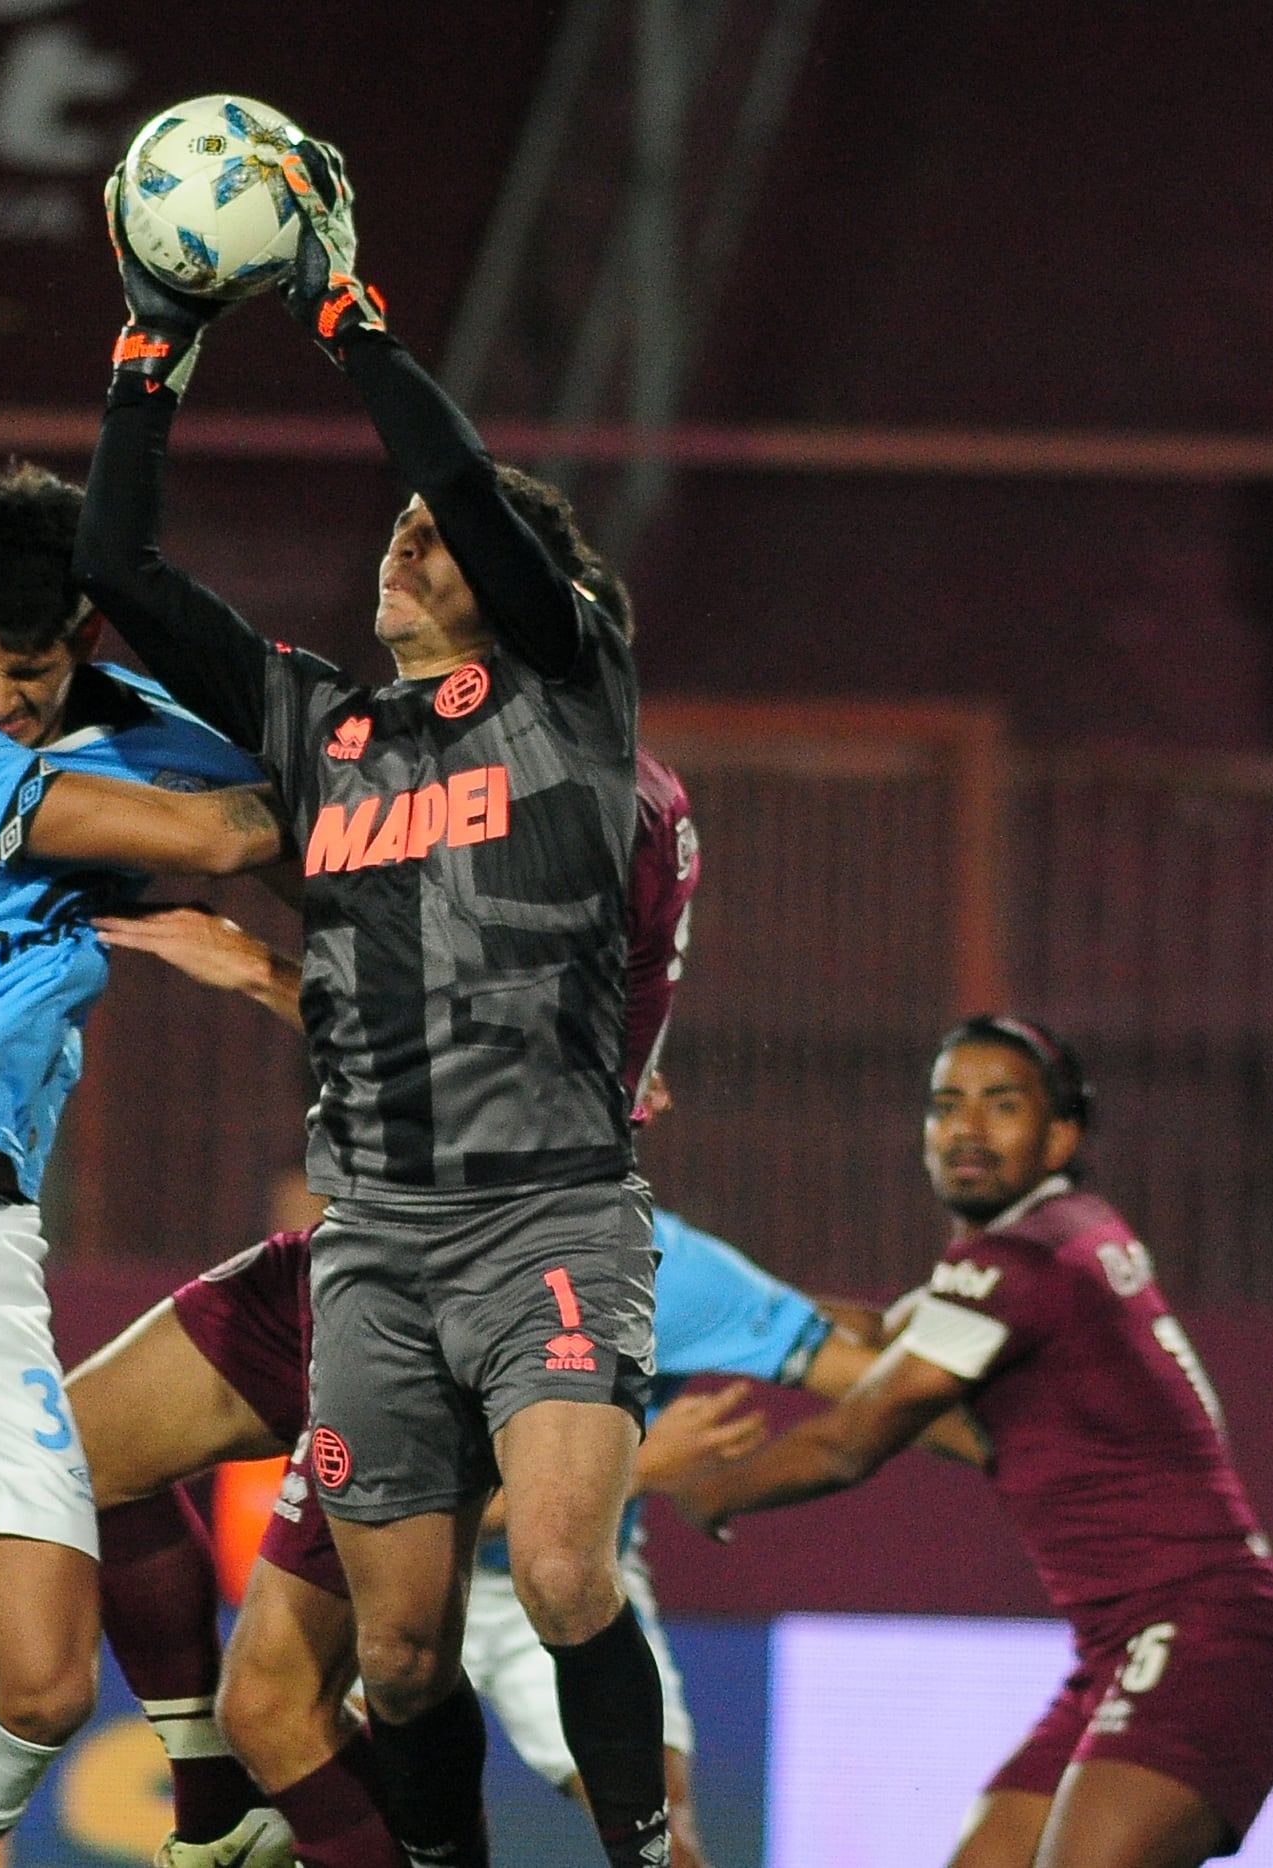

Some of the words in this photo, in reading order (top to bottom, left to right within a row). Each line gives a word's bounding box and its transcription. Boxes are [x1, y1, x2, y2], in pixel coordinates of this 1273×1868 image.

[305, 765, 509, 877] MAPEI
[544, 1268, 580, 1328] 1
[22, 1368, 72, 1451] 3
